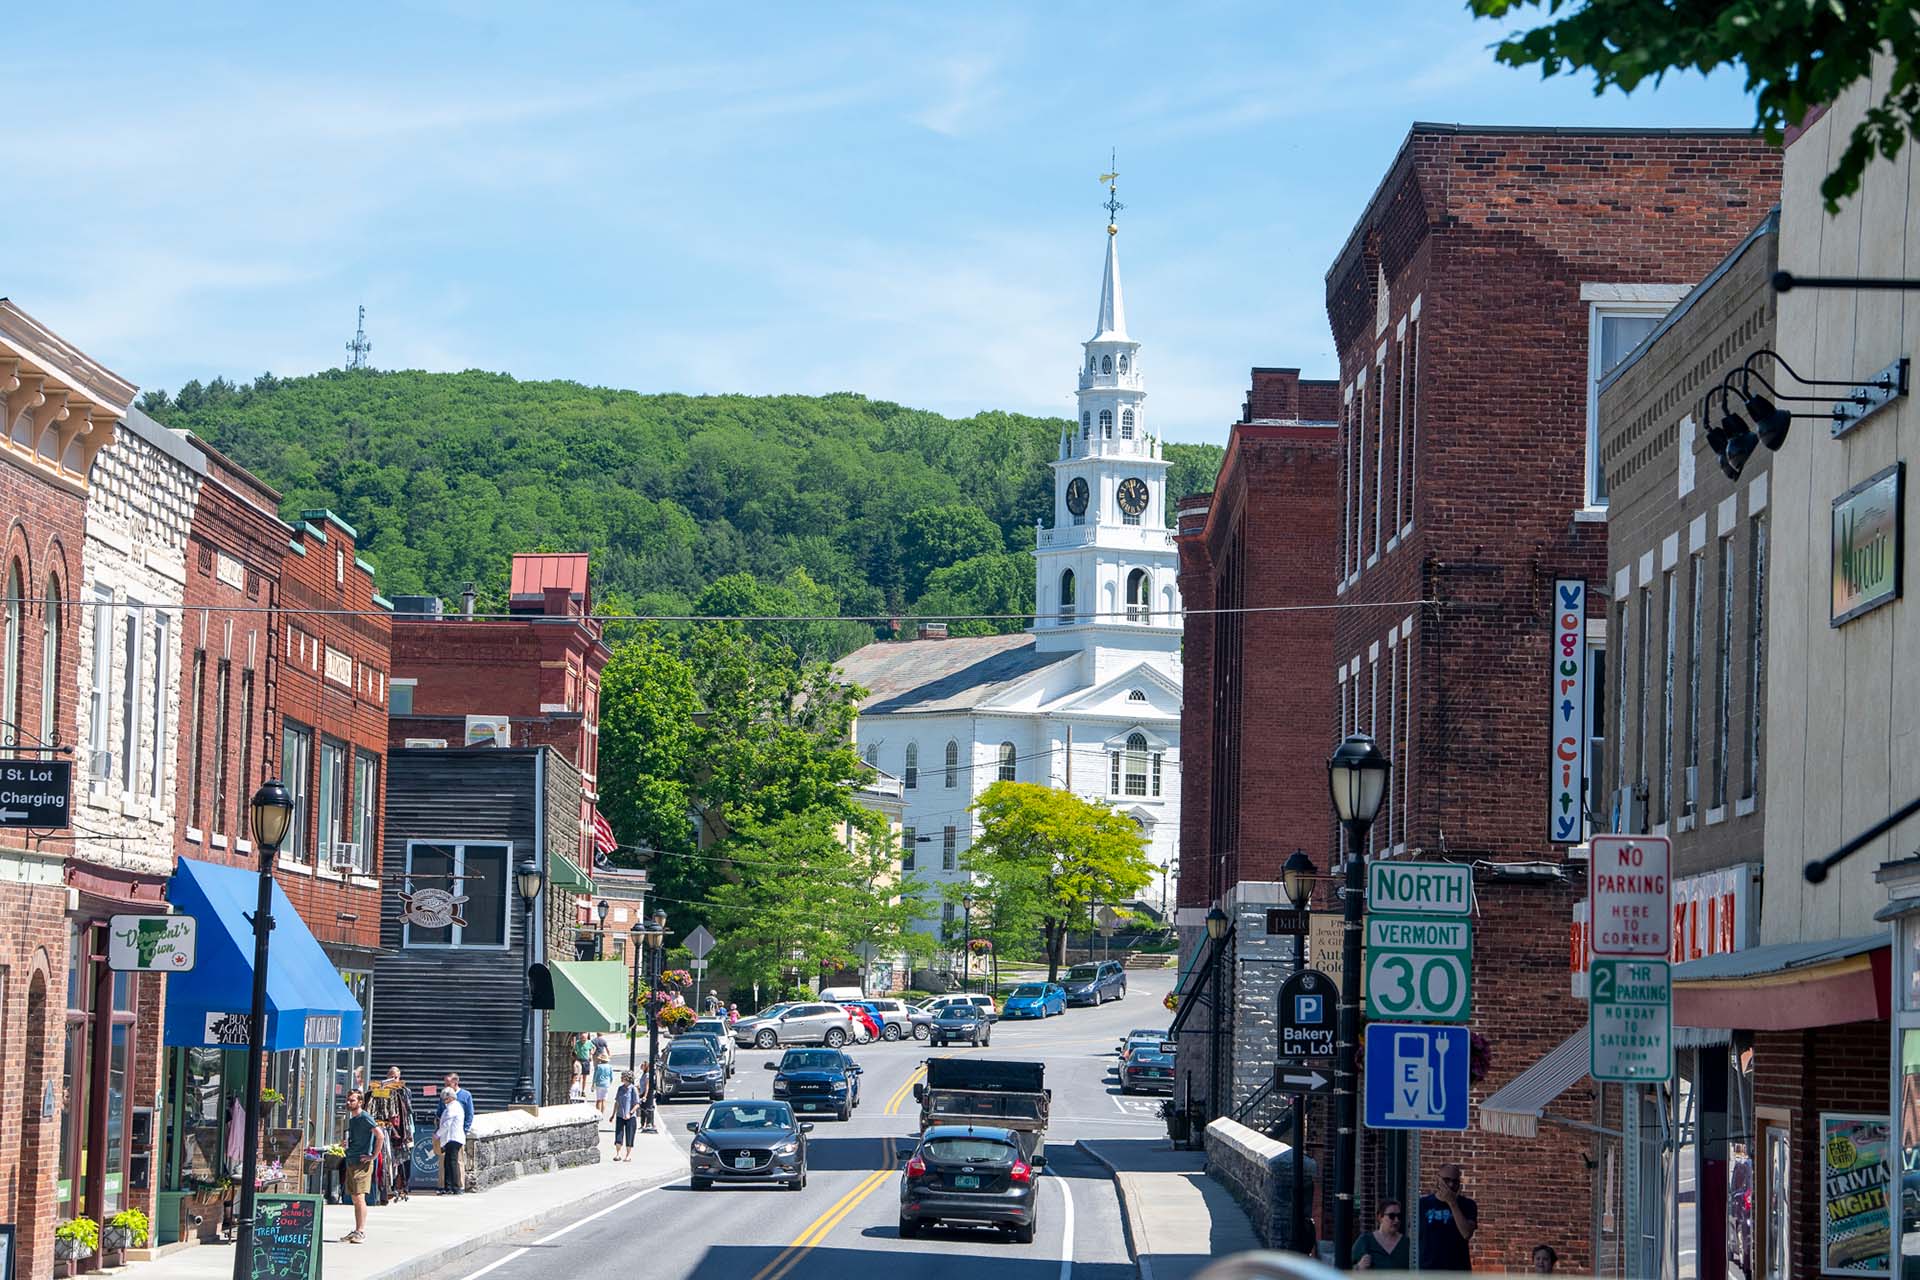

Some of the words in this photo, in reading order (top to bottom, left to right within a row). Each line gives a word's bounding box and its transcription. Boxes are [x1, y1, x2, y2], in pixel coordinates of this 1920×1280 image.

[1559, 585, 1582, 722] Yogurt
[7, 768, 25, 781] St.
[30, 769, 53, 782] Lot
[1556, 736, 1577, 839] City
[1, 791, 65, 808] Charging
[1618, 847, 1643, 867] NO
[1377, 868, 1462, 903] NORTH
[1598, 874, 1664, 895] PARKING
[1612, 905, 1649, 918] HERE
[1624, 919, 1639, 931] TO
[1668, 893, 1735, 964] KLIN
[1378, 924, 1460, 945] VERMONT
[1602, 932, 1660, 945] CORNER
[1379, 956, 1458, 1014] 30
[1595, 967, 1612, 997] 2
[1631, 967, 1651, 981] HR
[1617, 983, 1666, 1000] PARKING
[1300, 997, 1317, 1021] P
[1605, 1007, 1656, 1019] MONDAY
[228, 1014, 248, 1026] BUY
[1625, 1021, 1638, 1033] TO
[218, 1024, 249, 1034] AGAIN
[1284, 1027, 1333, 1043] Bakery
[221, 1034, 251, 1045] ALLEY
[1284, 1041, 1306, 1055] Ln.
[1310, 1041, 1334, 1055] Lot
[1600, 1034, 1661, 1048] SATURDAY
[1403, 1064, 1420, 1108] EV
[1827, 1164, 1889, 1196] TRIVIA
[1828, 1190, 1883, 1220] NIGHT
